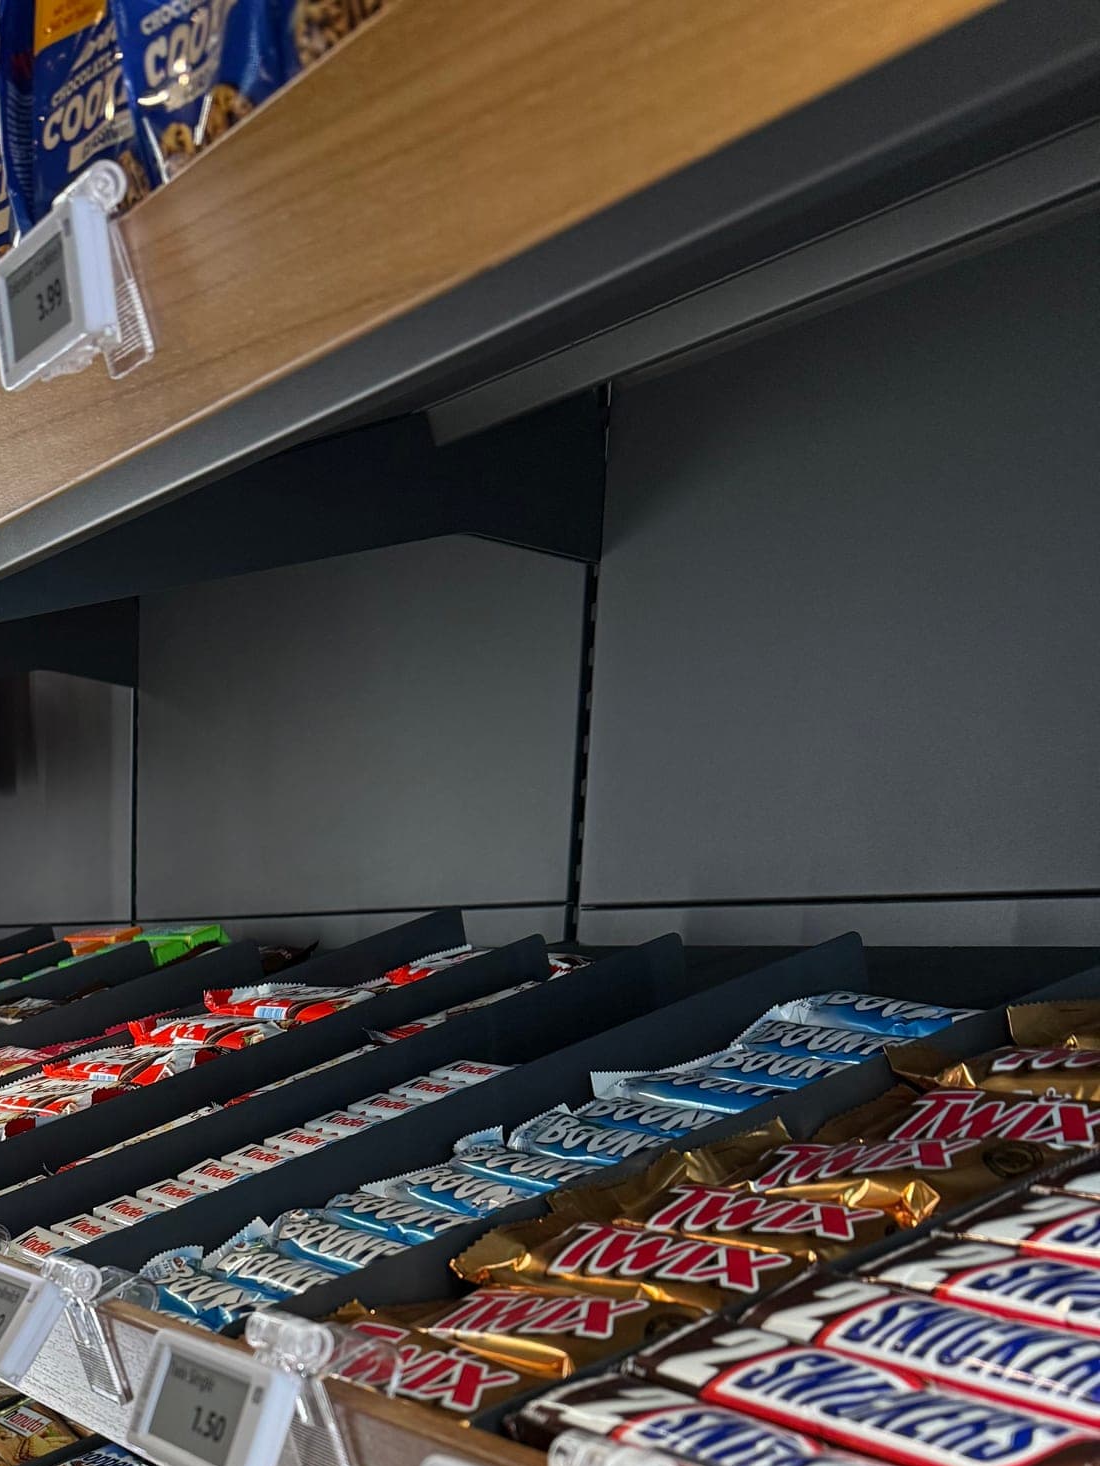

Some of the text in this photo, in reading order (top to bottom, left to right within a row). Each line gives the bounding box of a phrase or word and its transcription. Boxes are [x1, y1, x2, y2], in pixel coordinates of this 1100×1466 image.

[36, 278, 63, 321] 3.99
[447, 1061, 500, 1077] Kinder
[405, 1077, 456, 1095] Kinder
[364, 1094, 415, 1111] Kinder
[321, 1111, 371, 1129] Kinder
[277, 1129, 326, 1146] Kinder
[238, 1145, 285, 1165] Kinder
[193, 1161, 240, 1182] Kinder
[151, 1180, 197, 1201] Kinder
[107, 1195, 148, 1220] Kinder
[642, 1184, 887, 1242] TWIX
[63, 1213, 106, 1237] Kinder
[16, 1232, 54, 1257] Kinder
[548, 1221, 793, 1294] TWIX
[424, 1288, 650, 1340] TWIX
[657, 1326, 790, 1387] 2
[732, 1350, 1062, 1462] SNICKERS
[2, 1408, 47, 1433] hanuto
[191, 1405, 228, 1443] 1.50
